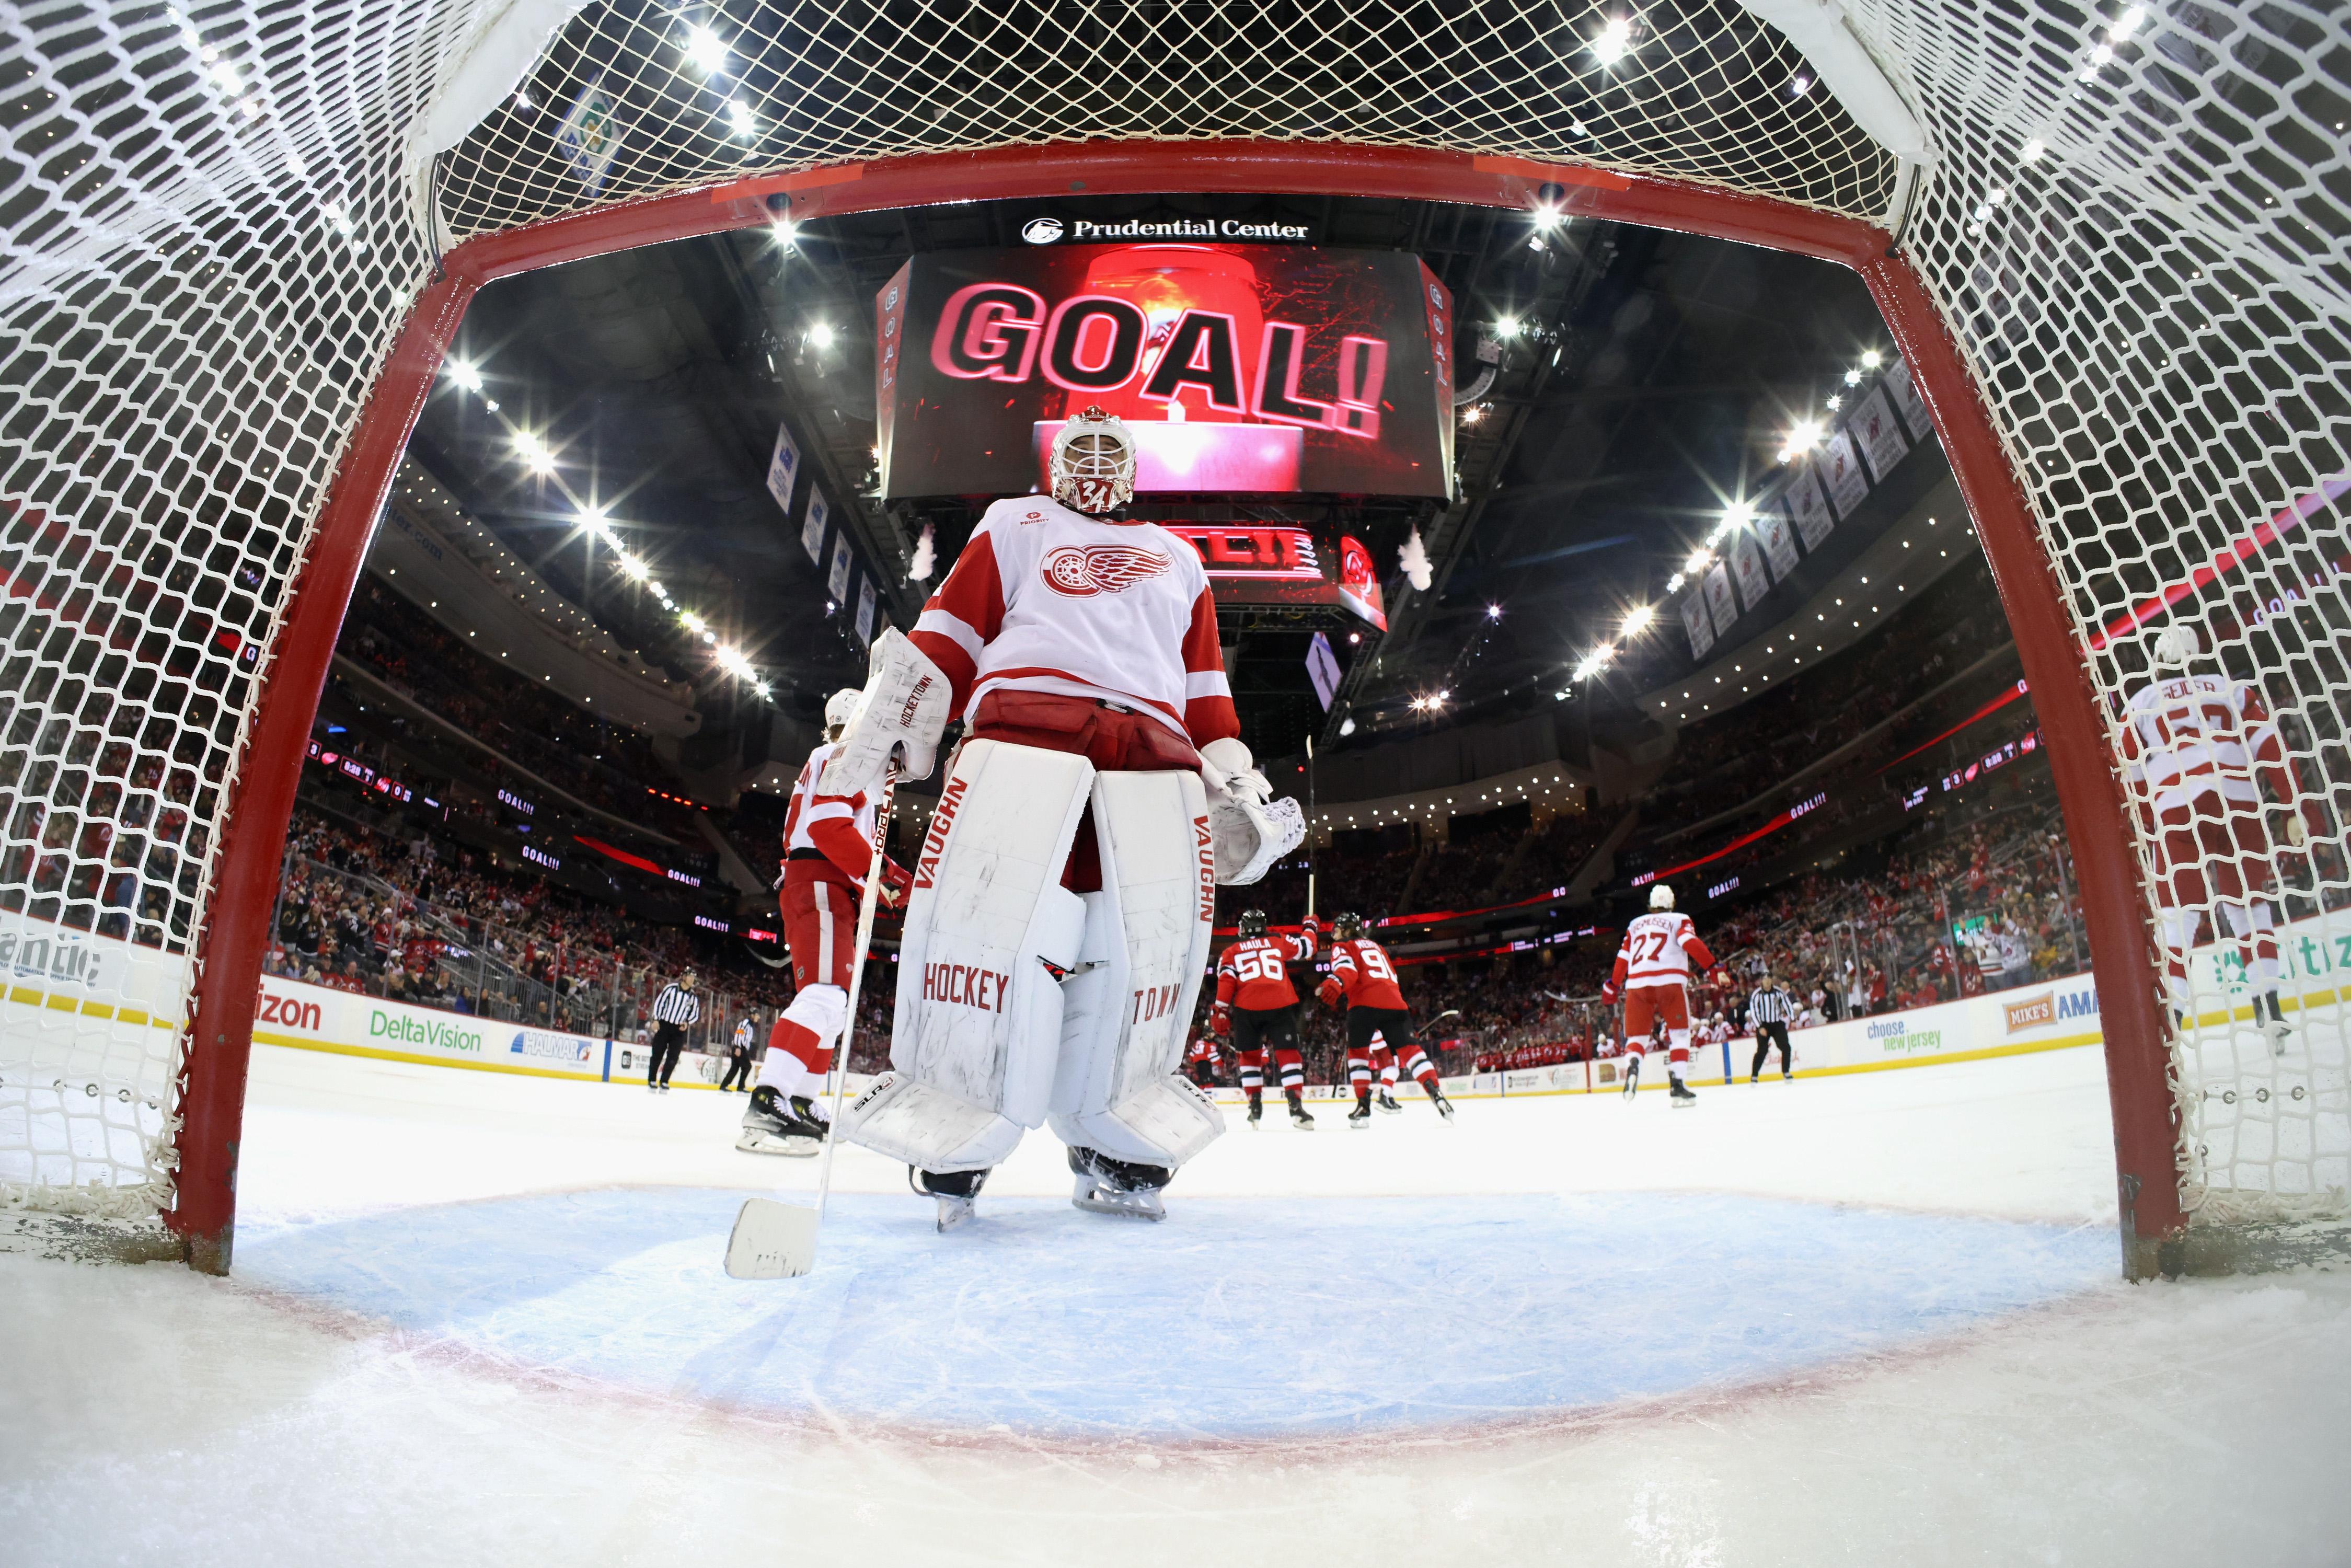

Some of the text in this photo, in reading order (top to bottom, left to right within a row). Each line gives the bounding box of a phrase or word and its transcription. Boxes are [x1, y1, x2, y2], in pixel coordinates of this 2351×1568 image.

[1073, 219, 1309, 238] Prudential Center
[931, 282, 1389, 440] GOAL!
[1082, 481, 1108, 514] 34
[900, 674, 933, 729] HOCKEYTOWN
[498, 789, 534, 815] GOAL!!!
[1790, 792, 1826, 820] GOAL!!!
[874, 815, 888, 855] PRO+
[914, 776, 968, 889] VAUGHN
[523, 845, 560, 871] GOAL!!!
[1193, 815, 1214, 923] VAUGHN
[668, 869, 700, 887] GOAL!!!
[1631, 871, 1655, 886] AL!!!
[1708, 877, 1740, 899] GOAL!!!
[695, 915, 729, 933] GOAL!!!
[1239, 938, 1271, 951] HAULA
[1632, 932, 1668, 966] 27
[1234, 948, 1283, 983] 56
[923, 962, 1009, 1014] HOCKEY
[1133, 983, 1181, 1025] TOWN
[2010, 1002, 2049, 1025] MIKE'S
[370, 1009, 481, 1052] DeltaVision
[1868, 1020, 1905, 1040] choose
[1884, 1029, 1941, 1053] new jersey
